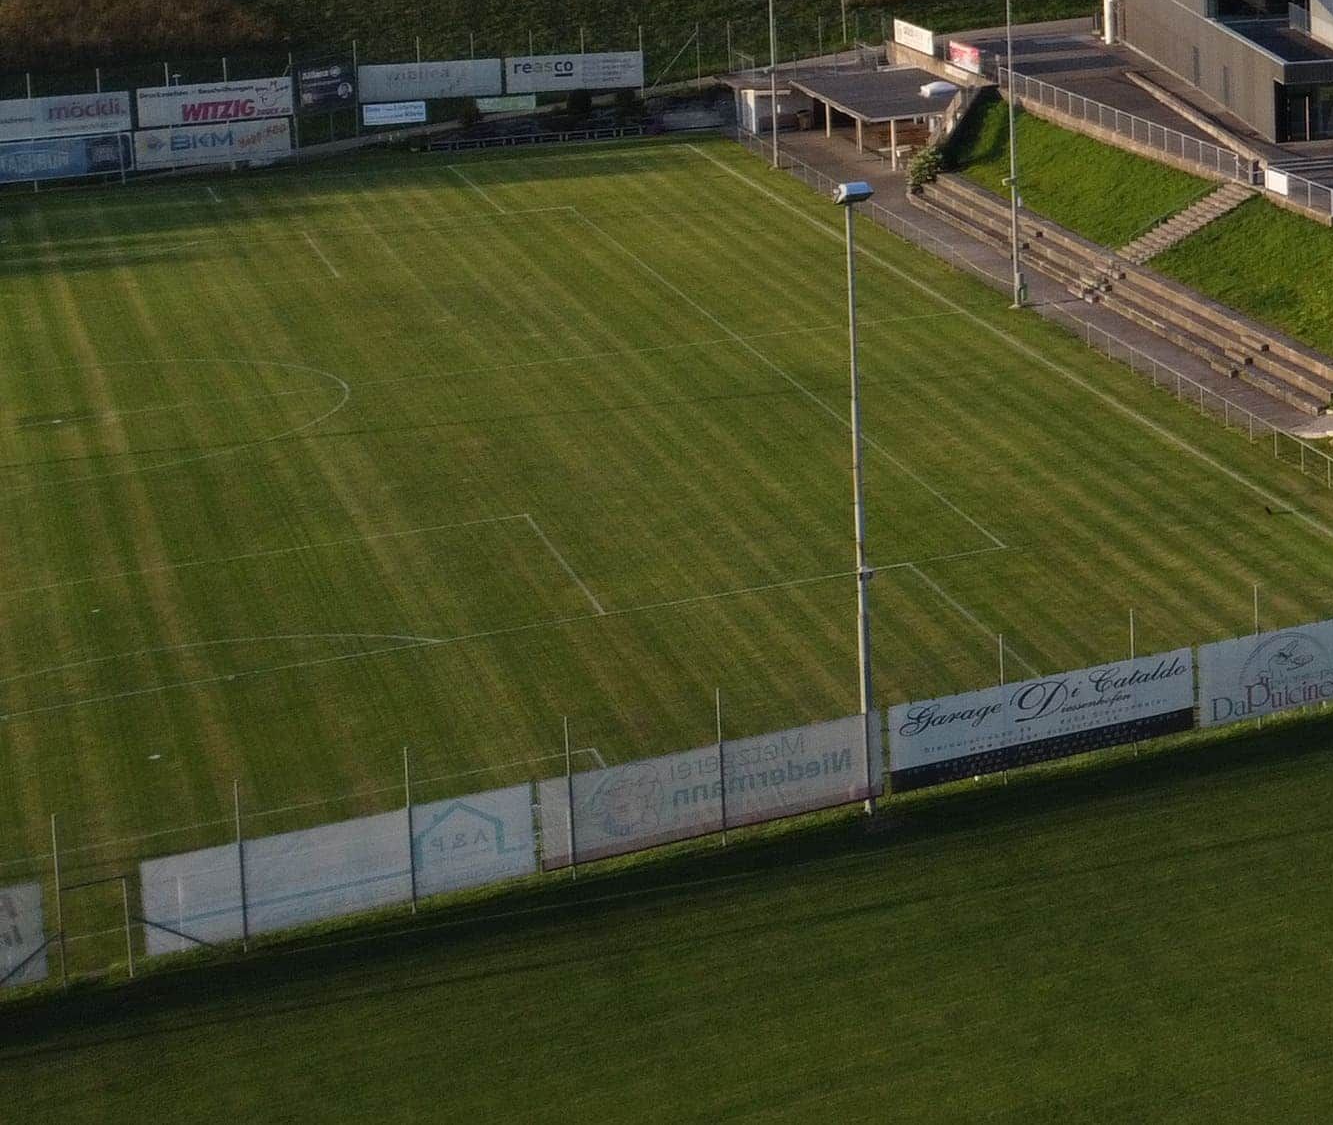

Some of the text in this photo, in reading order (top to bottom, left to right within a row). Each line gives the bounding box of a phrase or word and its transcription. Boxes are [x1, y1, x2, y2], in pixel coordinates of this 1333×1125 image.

[513, 60, 574, 77] reasco
[181, 99, 256, 122] WITZIG
[170, 130, 234, 152] BKM
[899, 657, 1187, 737] Garage Di Cataldo
